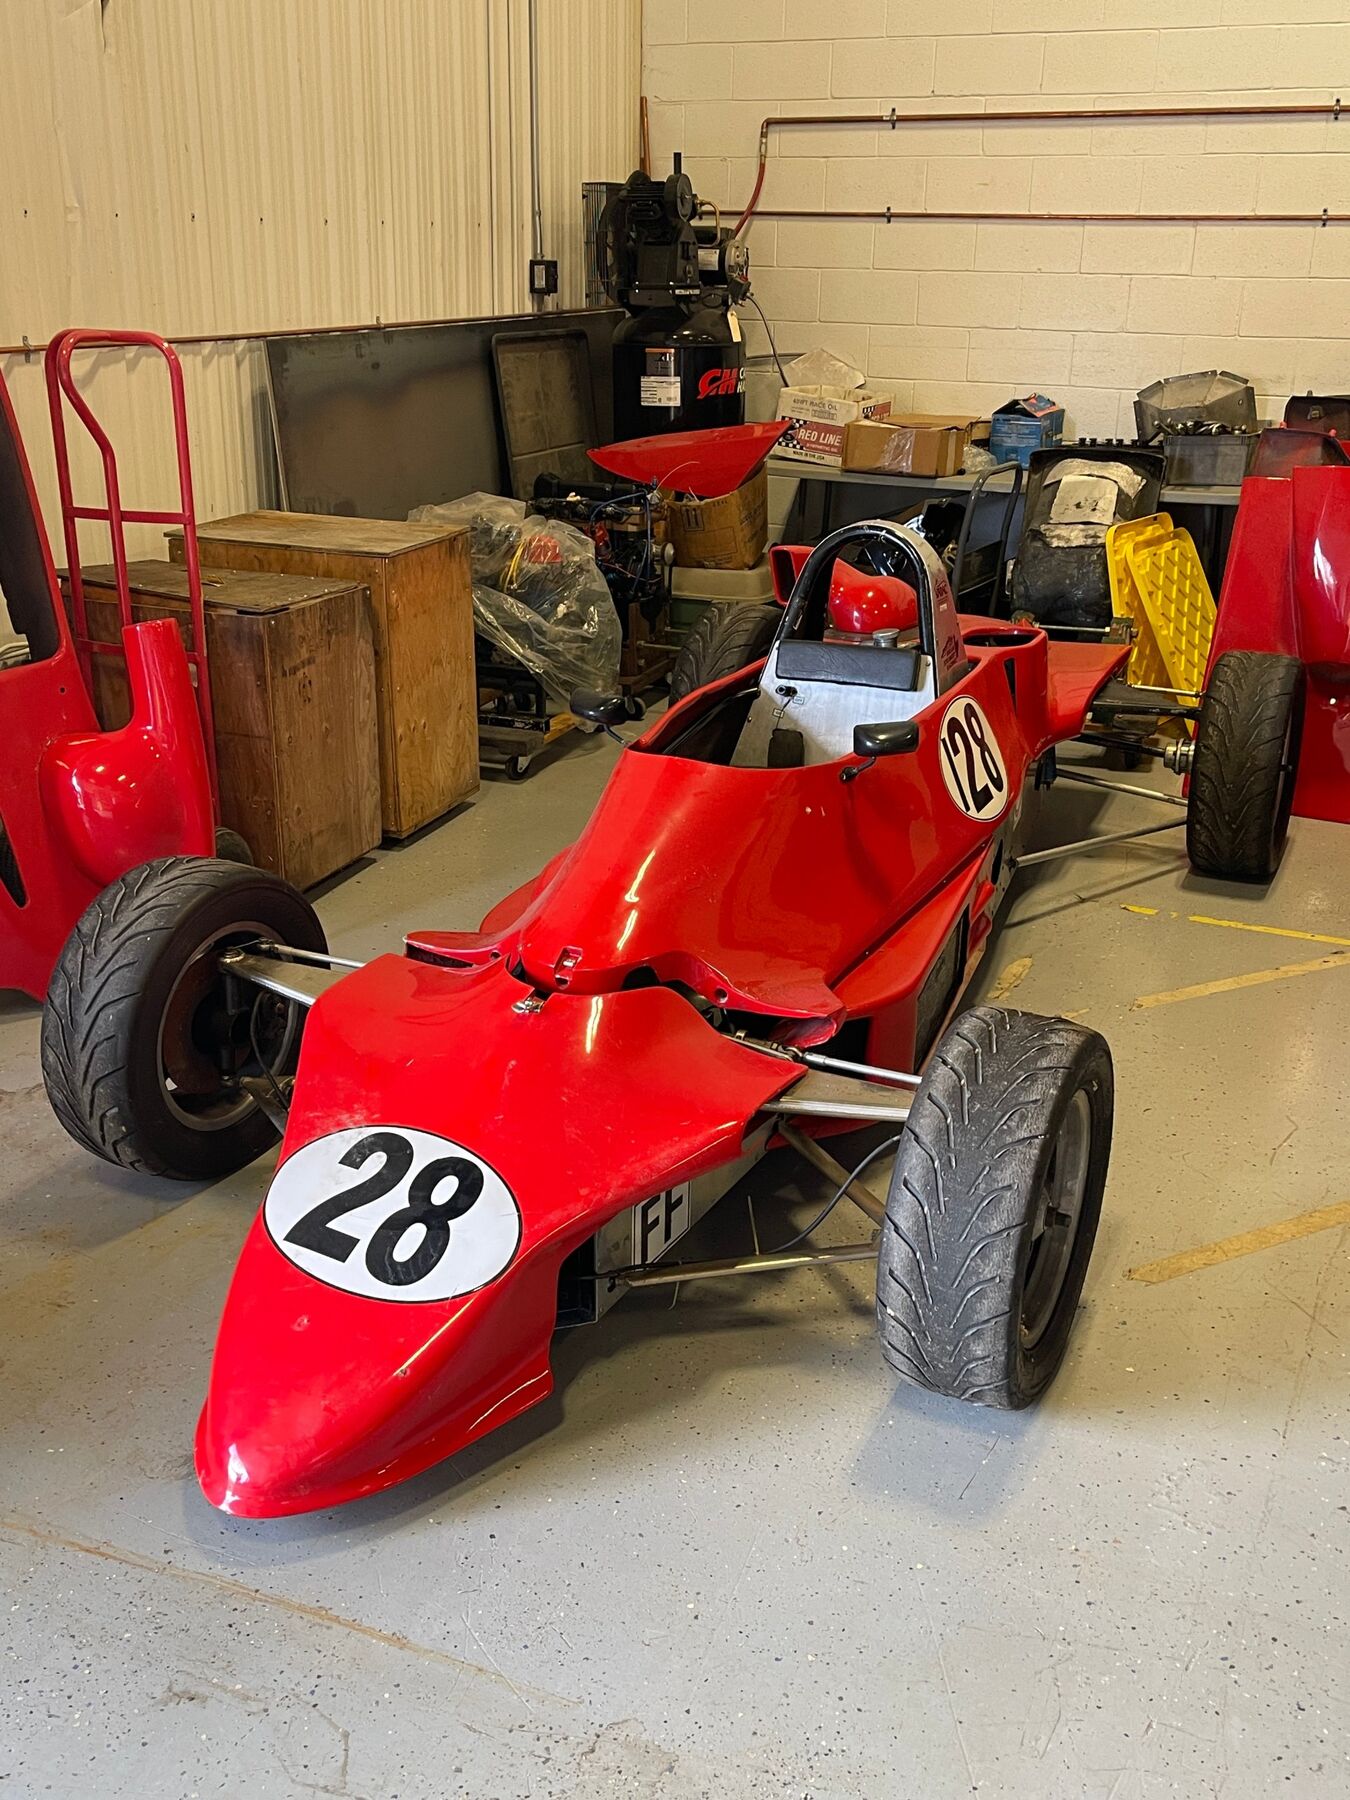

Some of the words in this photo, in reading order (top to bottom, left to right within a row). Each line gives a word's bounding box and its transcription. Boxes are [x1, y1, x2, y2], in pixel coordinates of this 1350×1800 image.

[798, 428, 818, 442] RED
[819, 432, 843, 446] LINE
[940, 702, 1004, 813] 128
[282, 1131, 485, 1287] 28
[641, 1190, 684, 1263] FF
